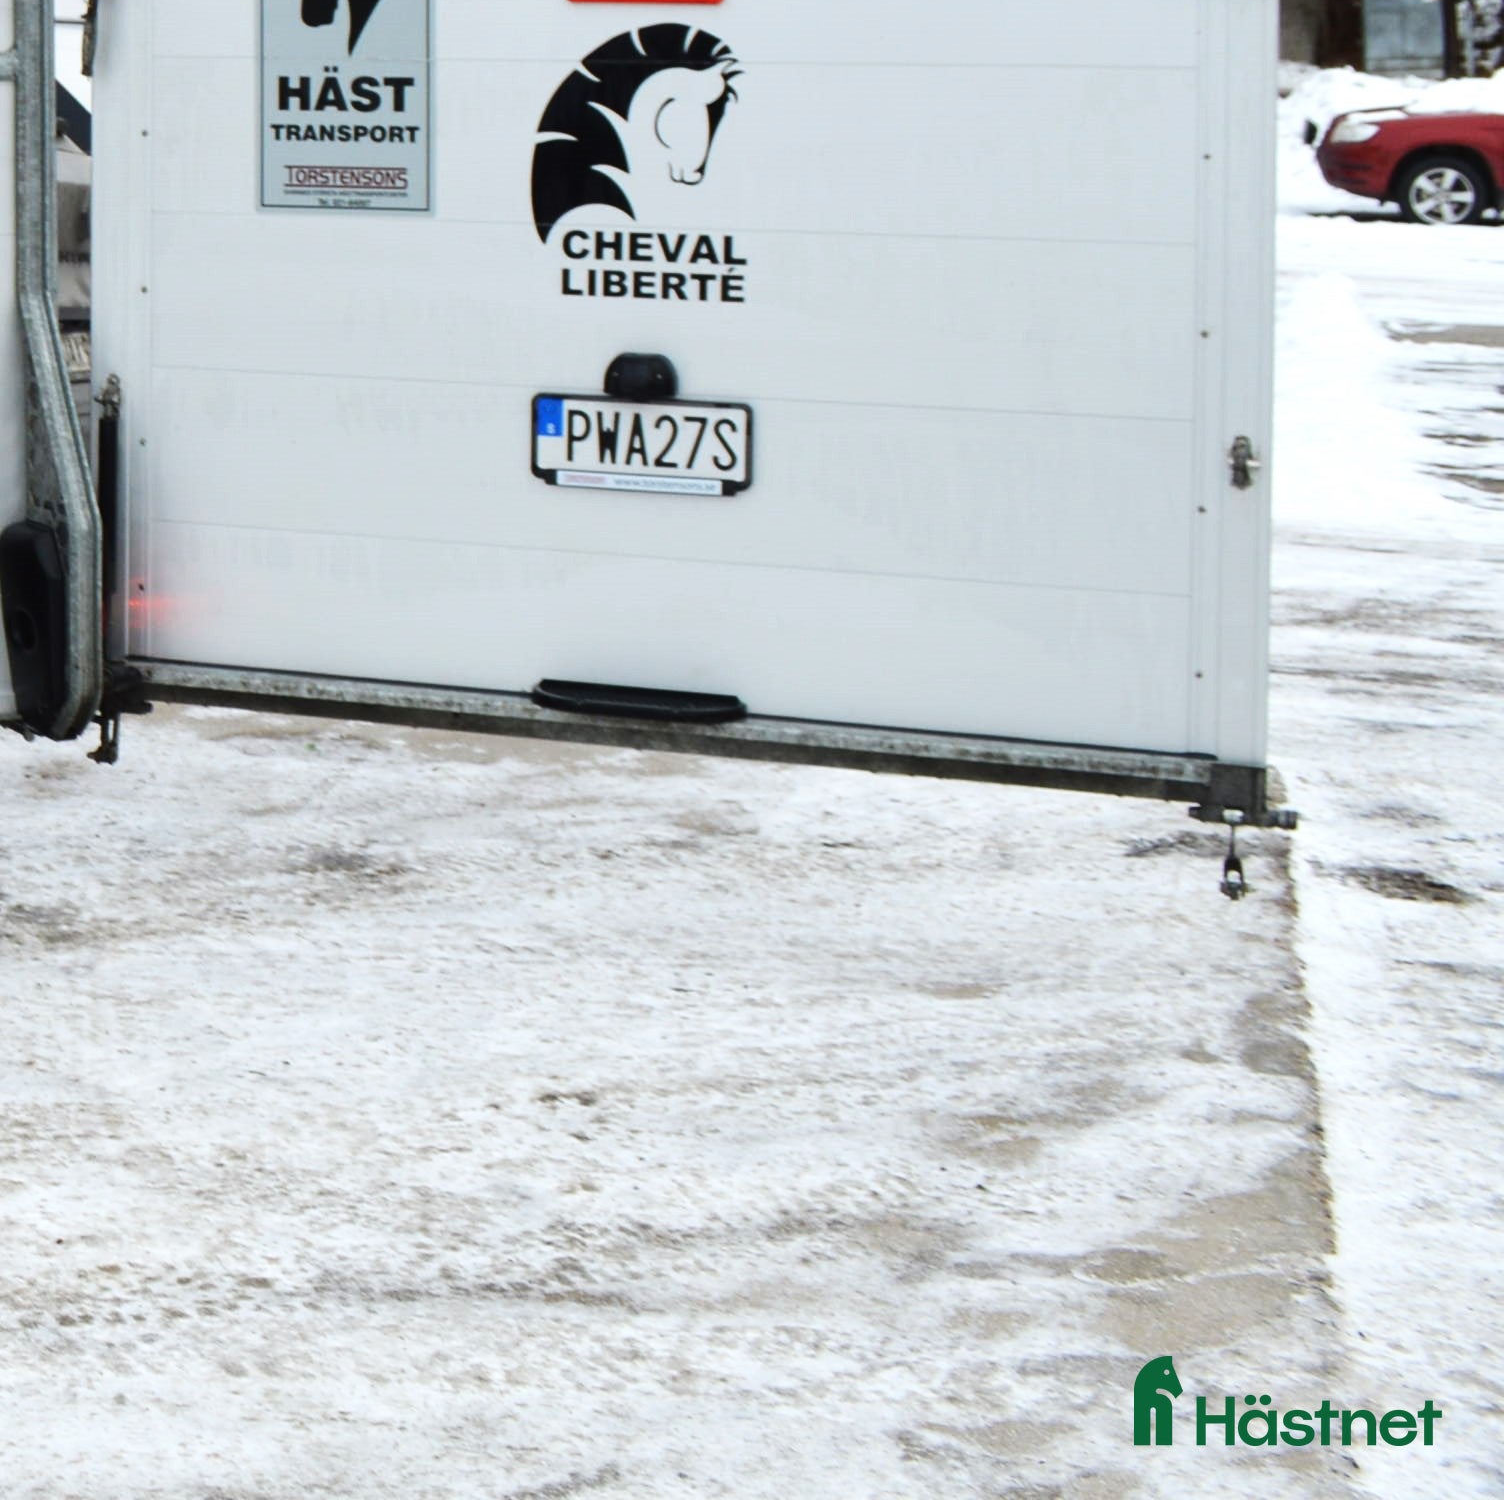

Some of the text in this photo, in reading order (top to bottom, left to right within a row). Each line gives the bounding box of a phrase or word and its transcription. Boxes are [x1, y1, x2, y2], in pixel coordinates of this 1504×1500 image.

[278, 65, 415, 113] HÄST
[270, 124, 420, 143] TRANSPORT
[283, 165, 408, 190] TORSTENSONS
[562, 230, 748, 266] CHEVAL
[561, 267, 745, 303] LIBERTÉ
